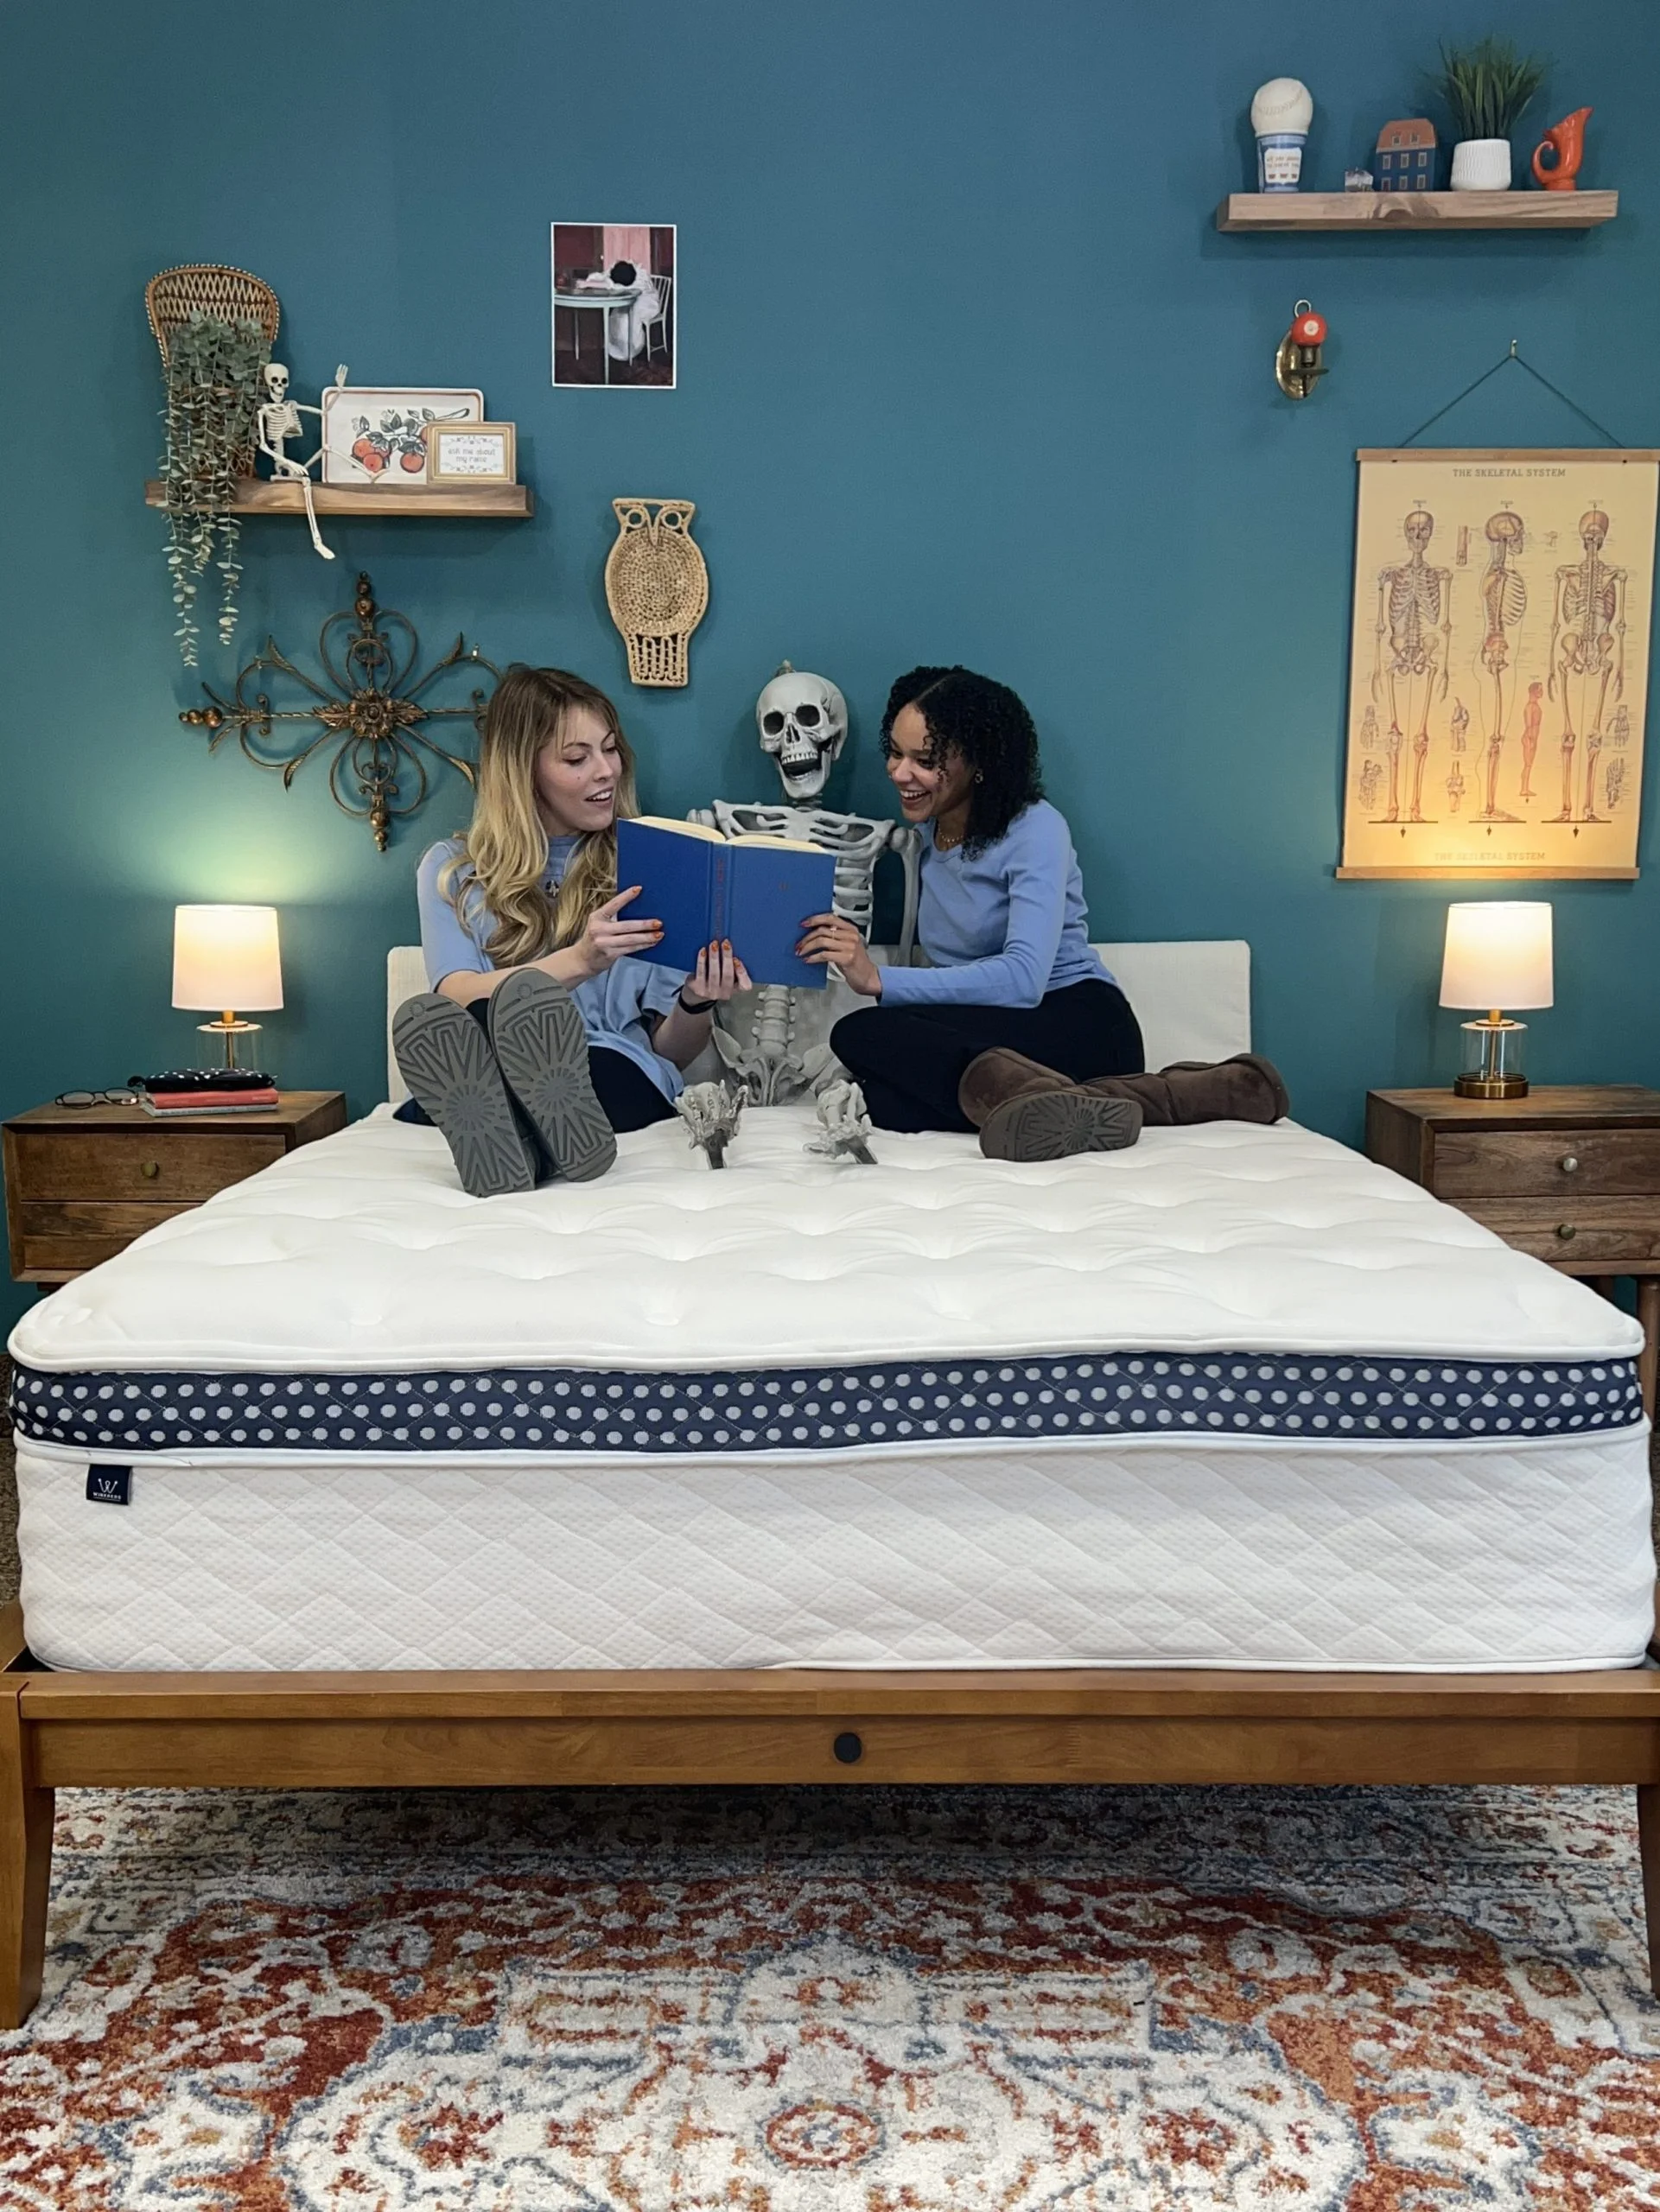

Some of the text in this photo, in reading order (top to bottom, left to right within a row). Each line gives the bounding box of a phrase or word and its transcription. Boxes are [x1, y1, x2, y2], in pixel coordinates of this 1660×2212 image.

[1453, 468, 1567, 478] THE SKELETAL SYSTEM
[1434, 852, 1453, 861] THE
[1506, 852, 1546, 861] SYSTEM
